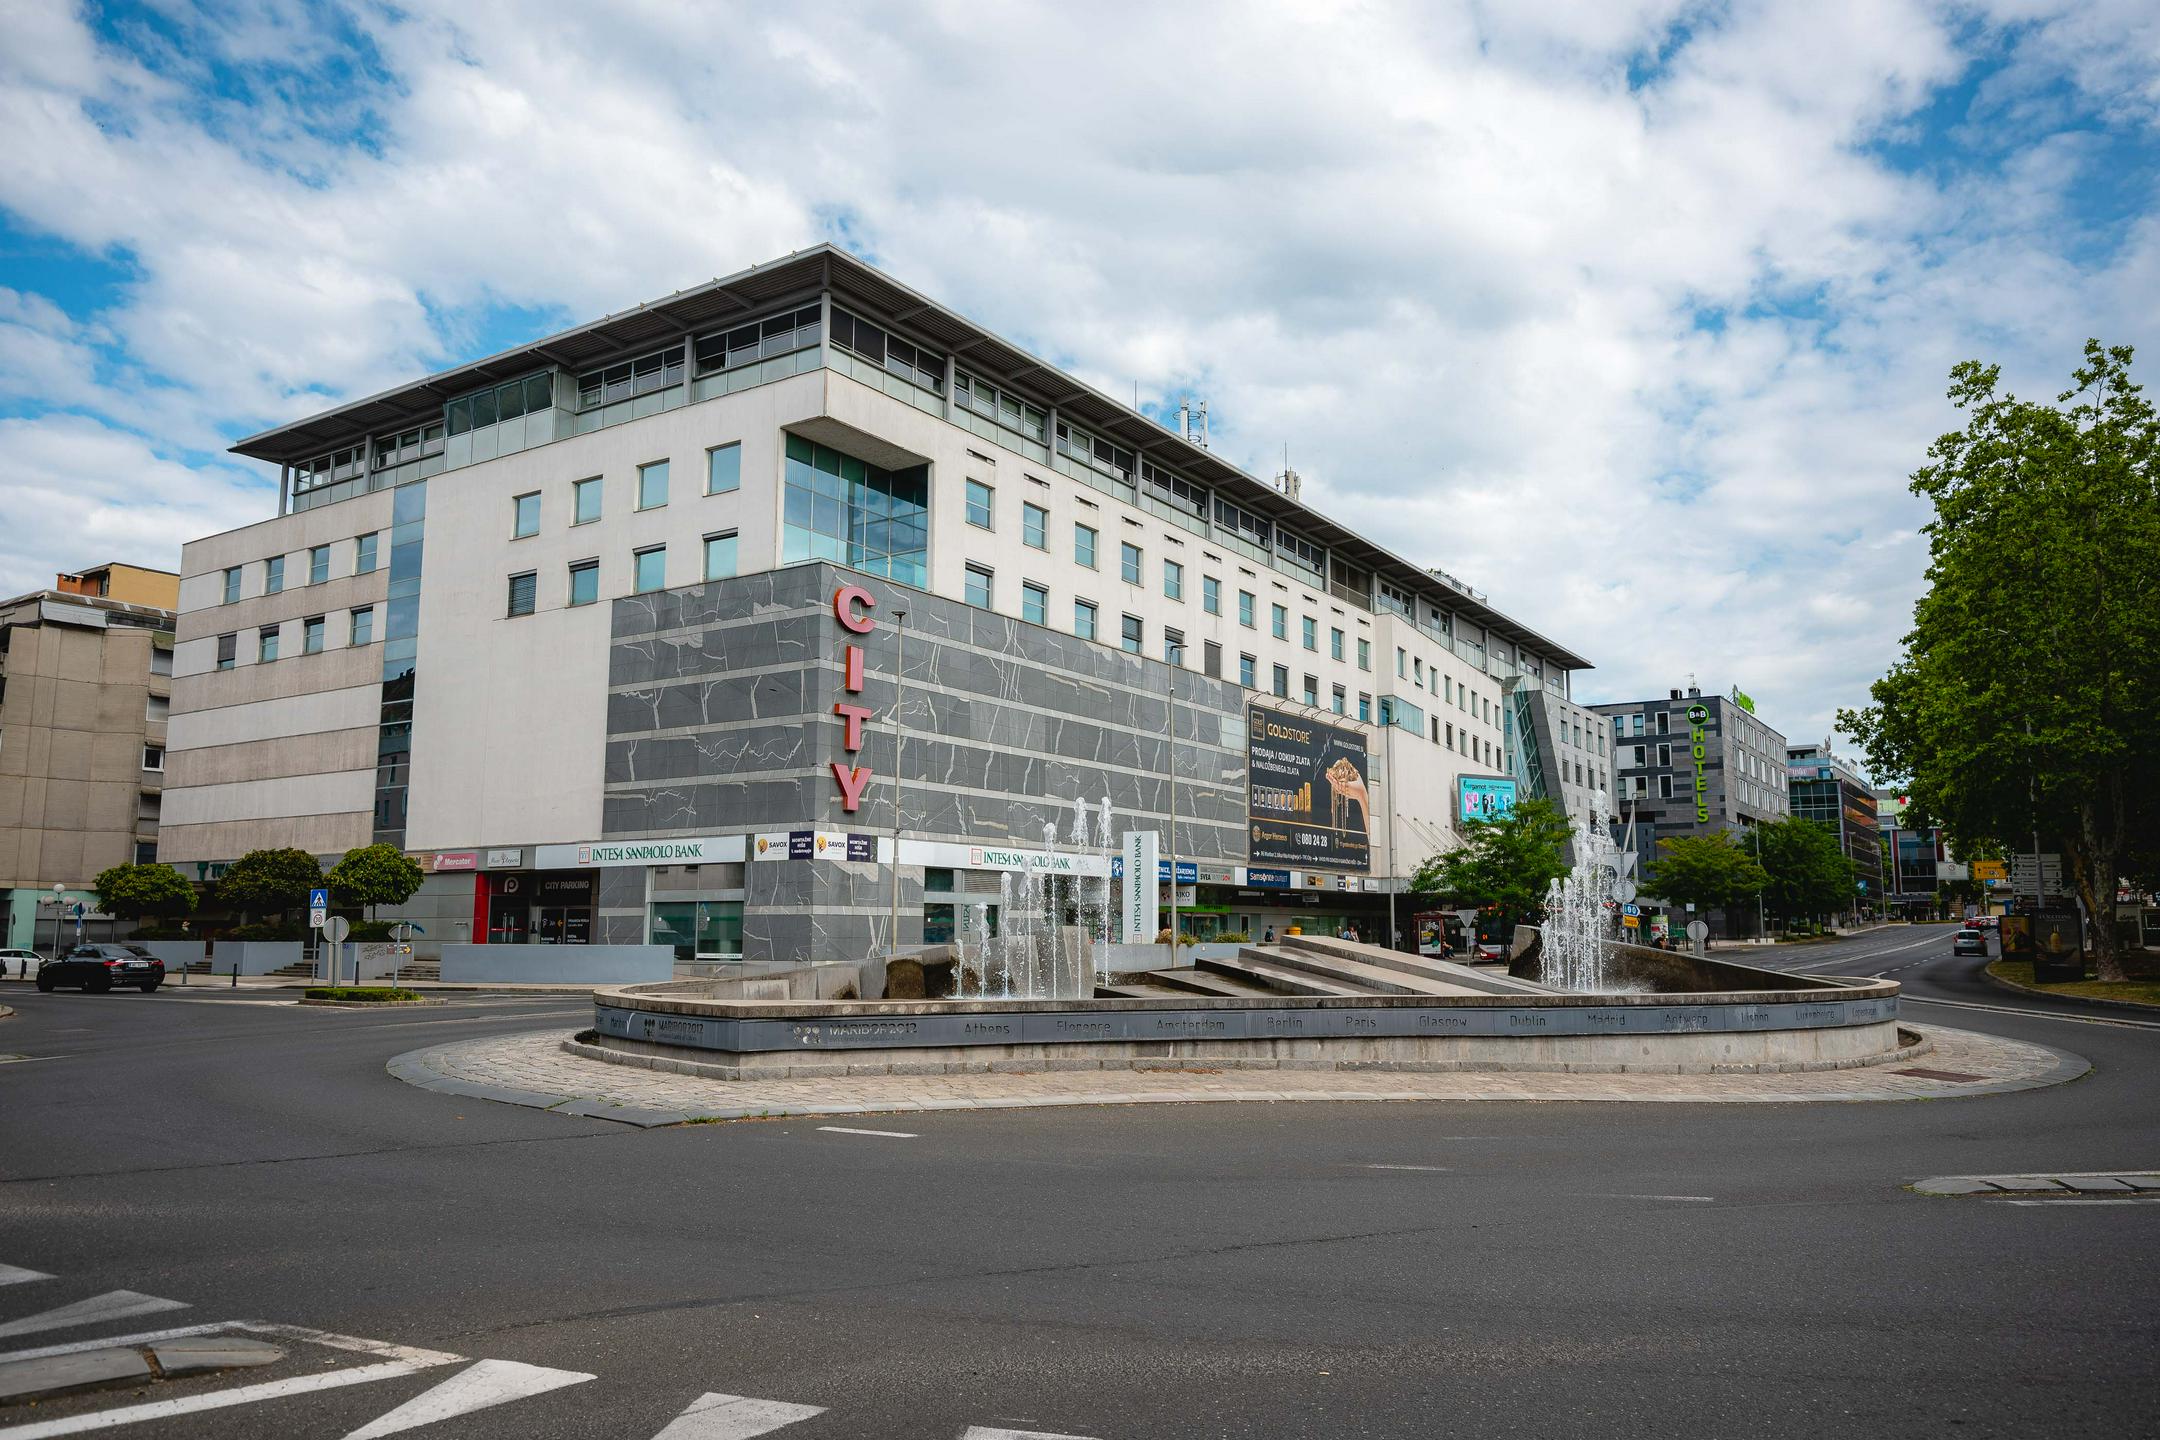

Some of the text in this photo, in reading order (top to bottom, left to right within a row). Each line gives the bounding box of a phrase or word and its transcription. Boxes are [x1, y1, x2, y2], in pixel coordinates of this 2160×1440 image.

[834, 586, 876, 812] CITY
[1689, 711, 1707, 719] B&B
[1267, 723, 1310, 744] GOLDSTORE
[1251, 746, 1275, 760] PRODAJA
[1278, 752, 1295, 763] ODKUP
[1296, 756, 1311, 767] ZLATA
[1287, 766, 1300, 776] ZLATA
[1692, 728, 1709, 823] HOTELS
[1134, 835, 1142, 858] BANK
[1301, 833, 1312, 845] 080
[1312, 834, 1320, 846] 24
[1320, 835, 1328, 848] 28
[592, 844, 703, 861] INTESA SANPAOLO BANK
[984, 851, 1011, 865] INTESA
[444, 857, 471, 866] Mercator
[1249, 872, 1274, 882] Samsonite
[545, 880, 589, 890] CITY PARKING
[1156, 1018, 1225, 1031] Amsterdam
[1266, 1016, 1303, 1029] Berlin
[1345, 1016, 1377, 1028] Paris
[1418, 1015, 1467, 1029] Glasgow
[1509, 1015, 1546, 1027] Dublin
[1588, 1014, 1626, 1025] Madrid
[1664, 1013, 1708, 1025] Antwerp
[829, 1022, 918, 1036] MARIBOR2012
[964, 1022, 1010, 1034] Athens
[1056, 1020, 1112, 1033] Florence
